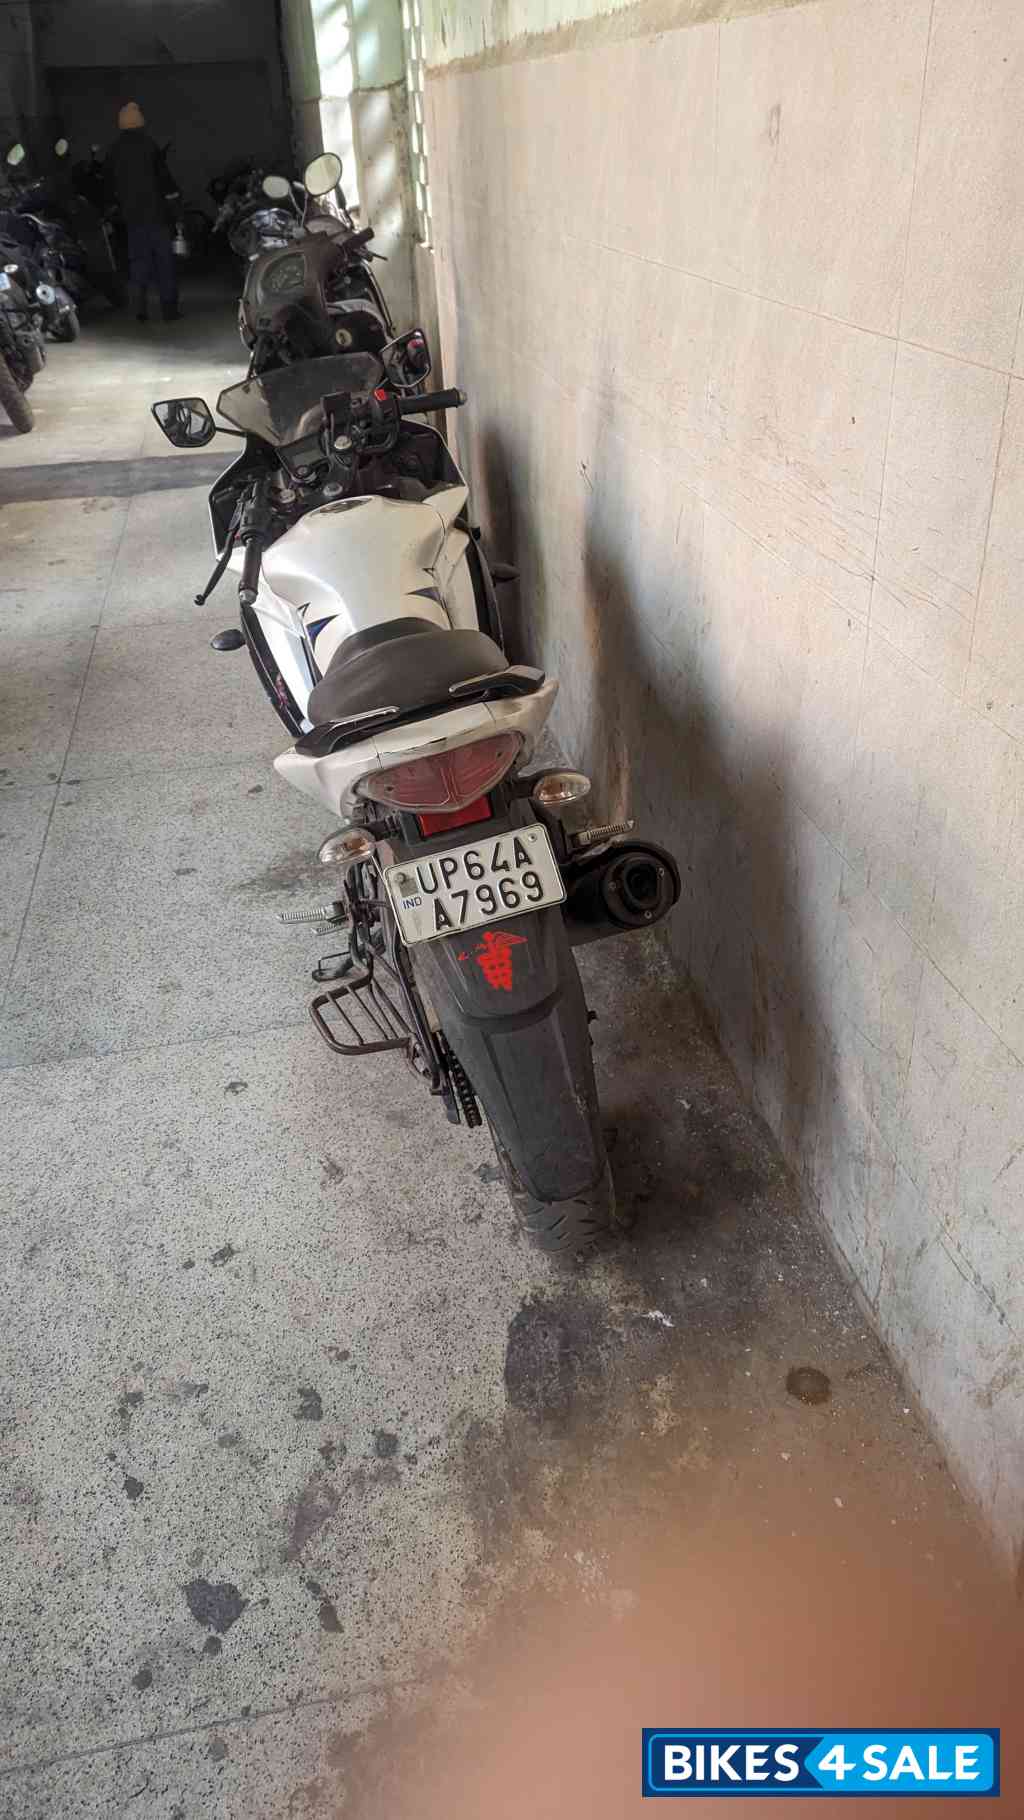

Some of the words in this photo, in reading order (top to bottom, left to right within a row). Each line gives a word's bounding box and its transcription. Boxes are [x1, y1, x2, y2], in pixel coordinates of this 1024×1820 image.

[416, 837, 533, 894] UP64A
[402, 896, 422, 909] IND
[433, 871, 544, 931] A7969
